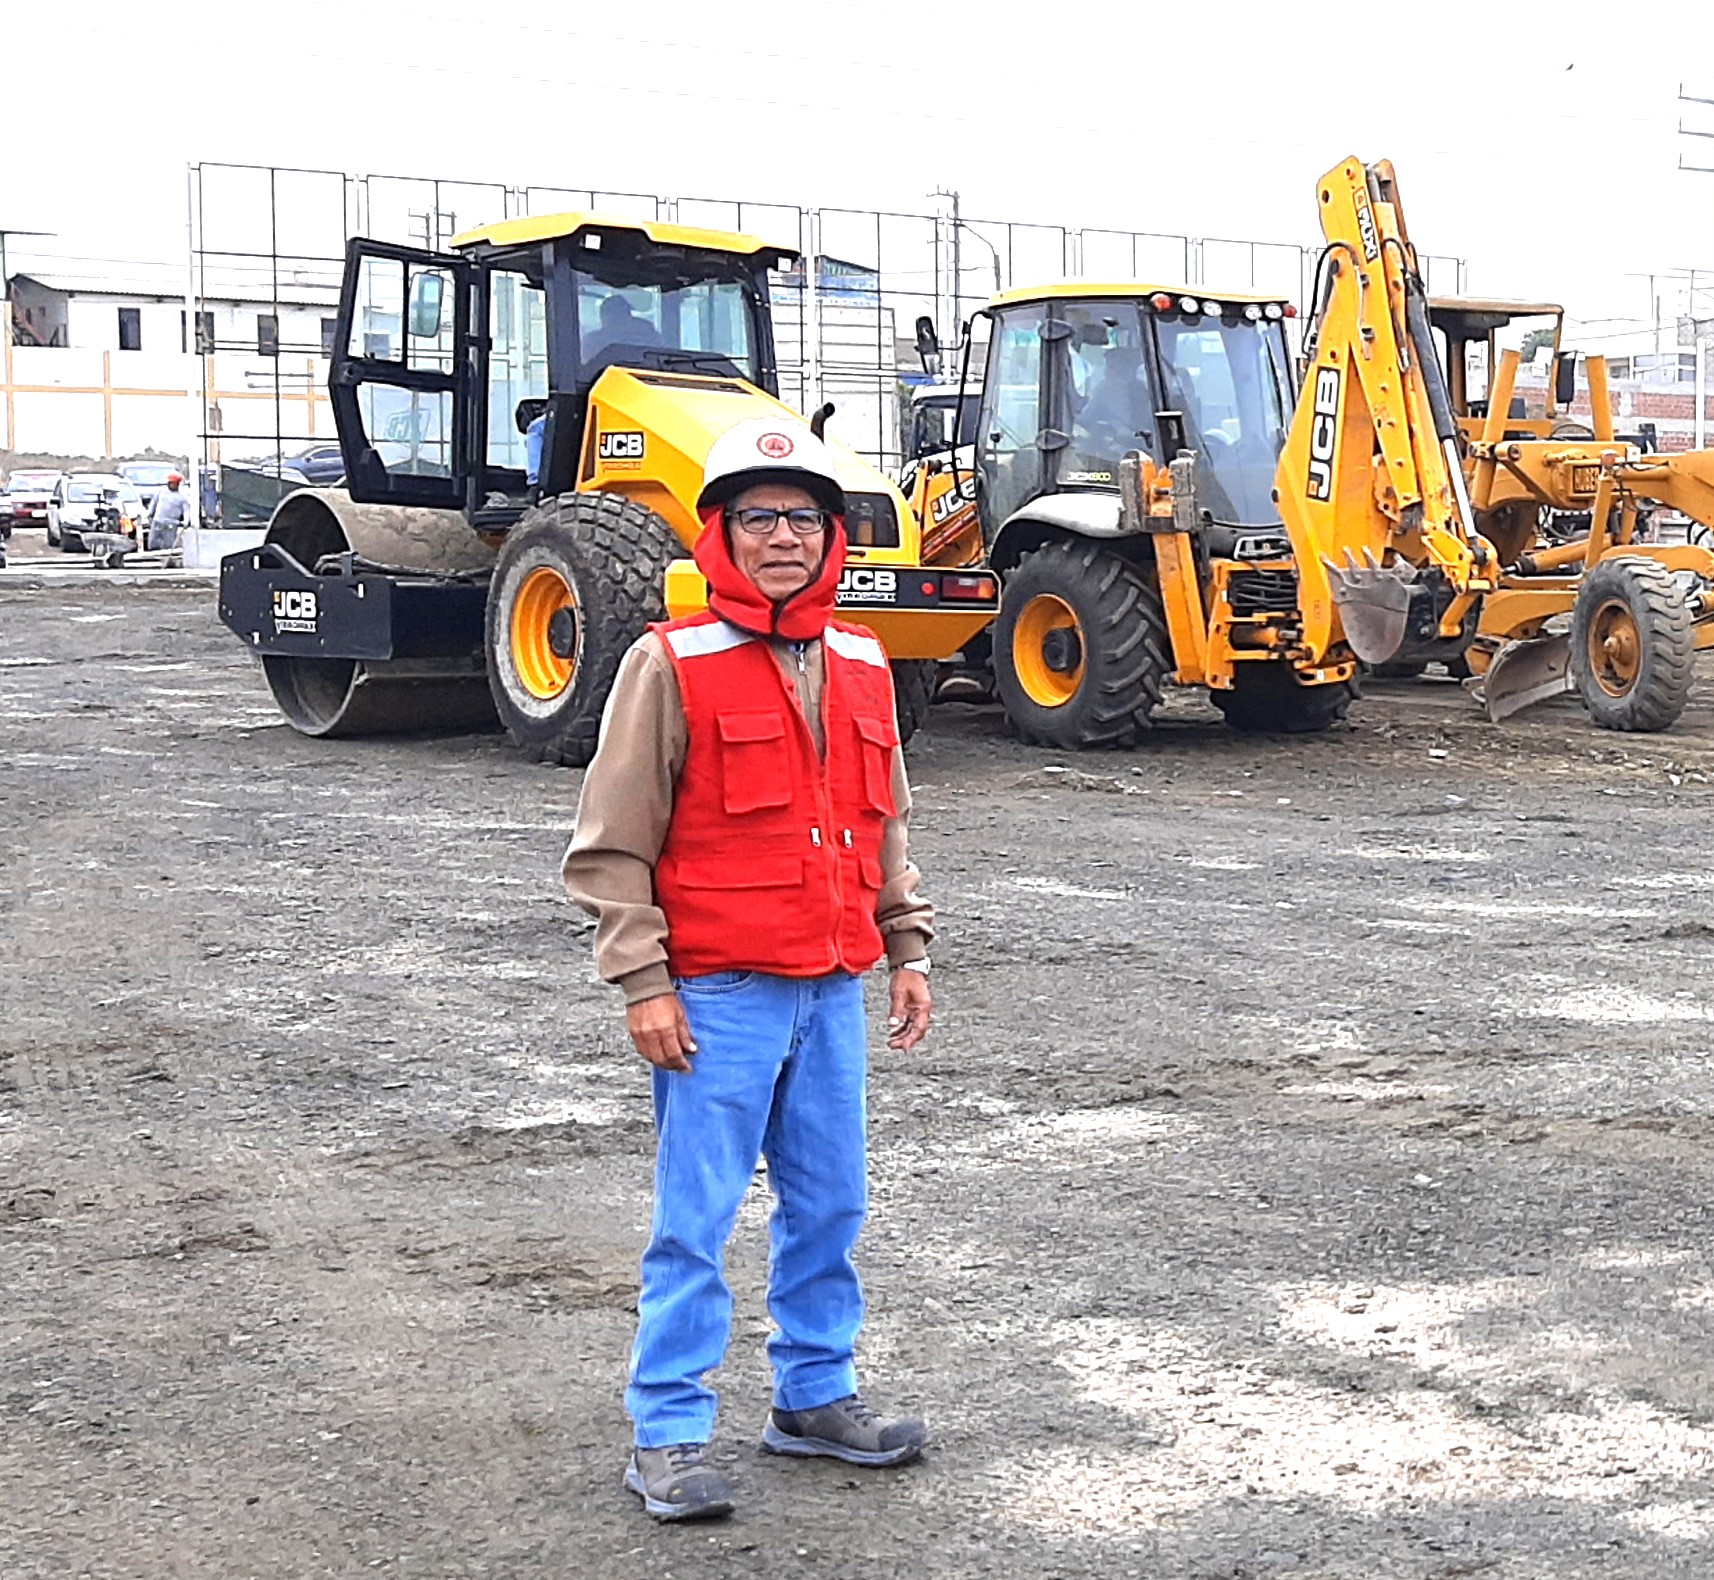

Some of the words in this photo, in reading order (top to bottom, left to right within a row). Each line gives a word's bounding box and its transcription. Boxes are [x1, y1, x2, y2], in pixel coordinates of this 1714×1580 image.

[600, 434, 643, 457] JCB
[1309, 369, 1339, 499] JCB
[837, 569, 897, 591] JCB
[273, 591, 317, 618] JCB
